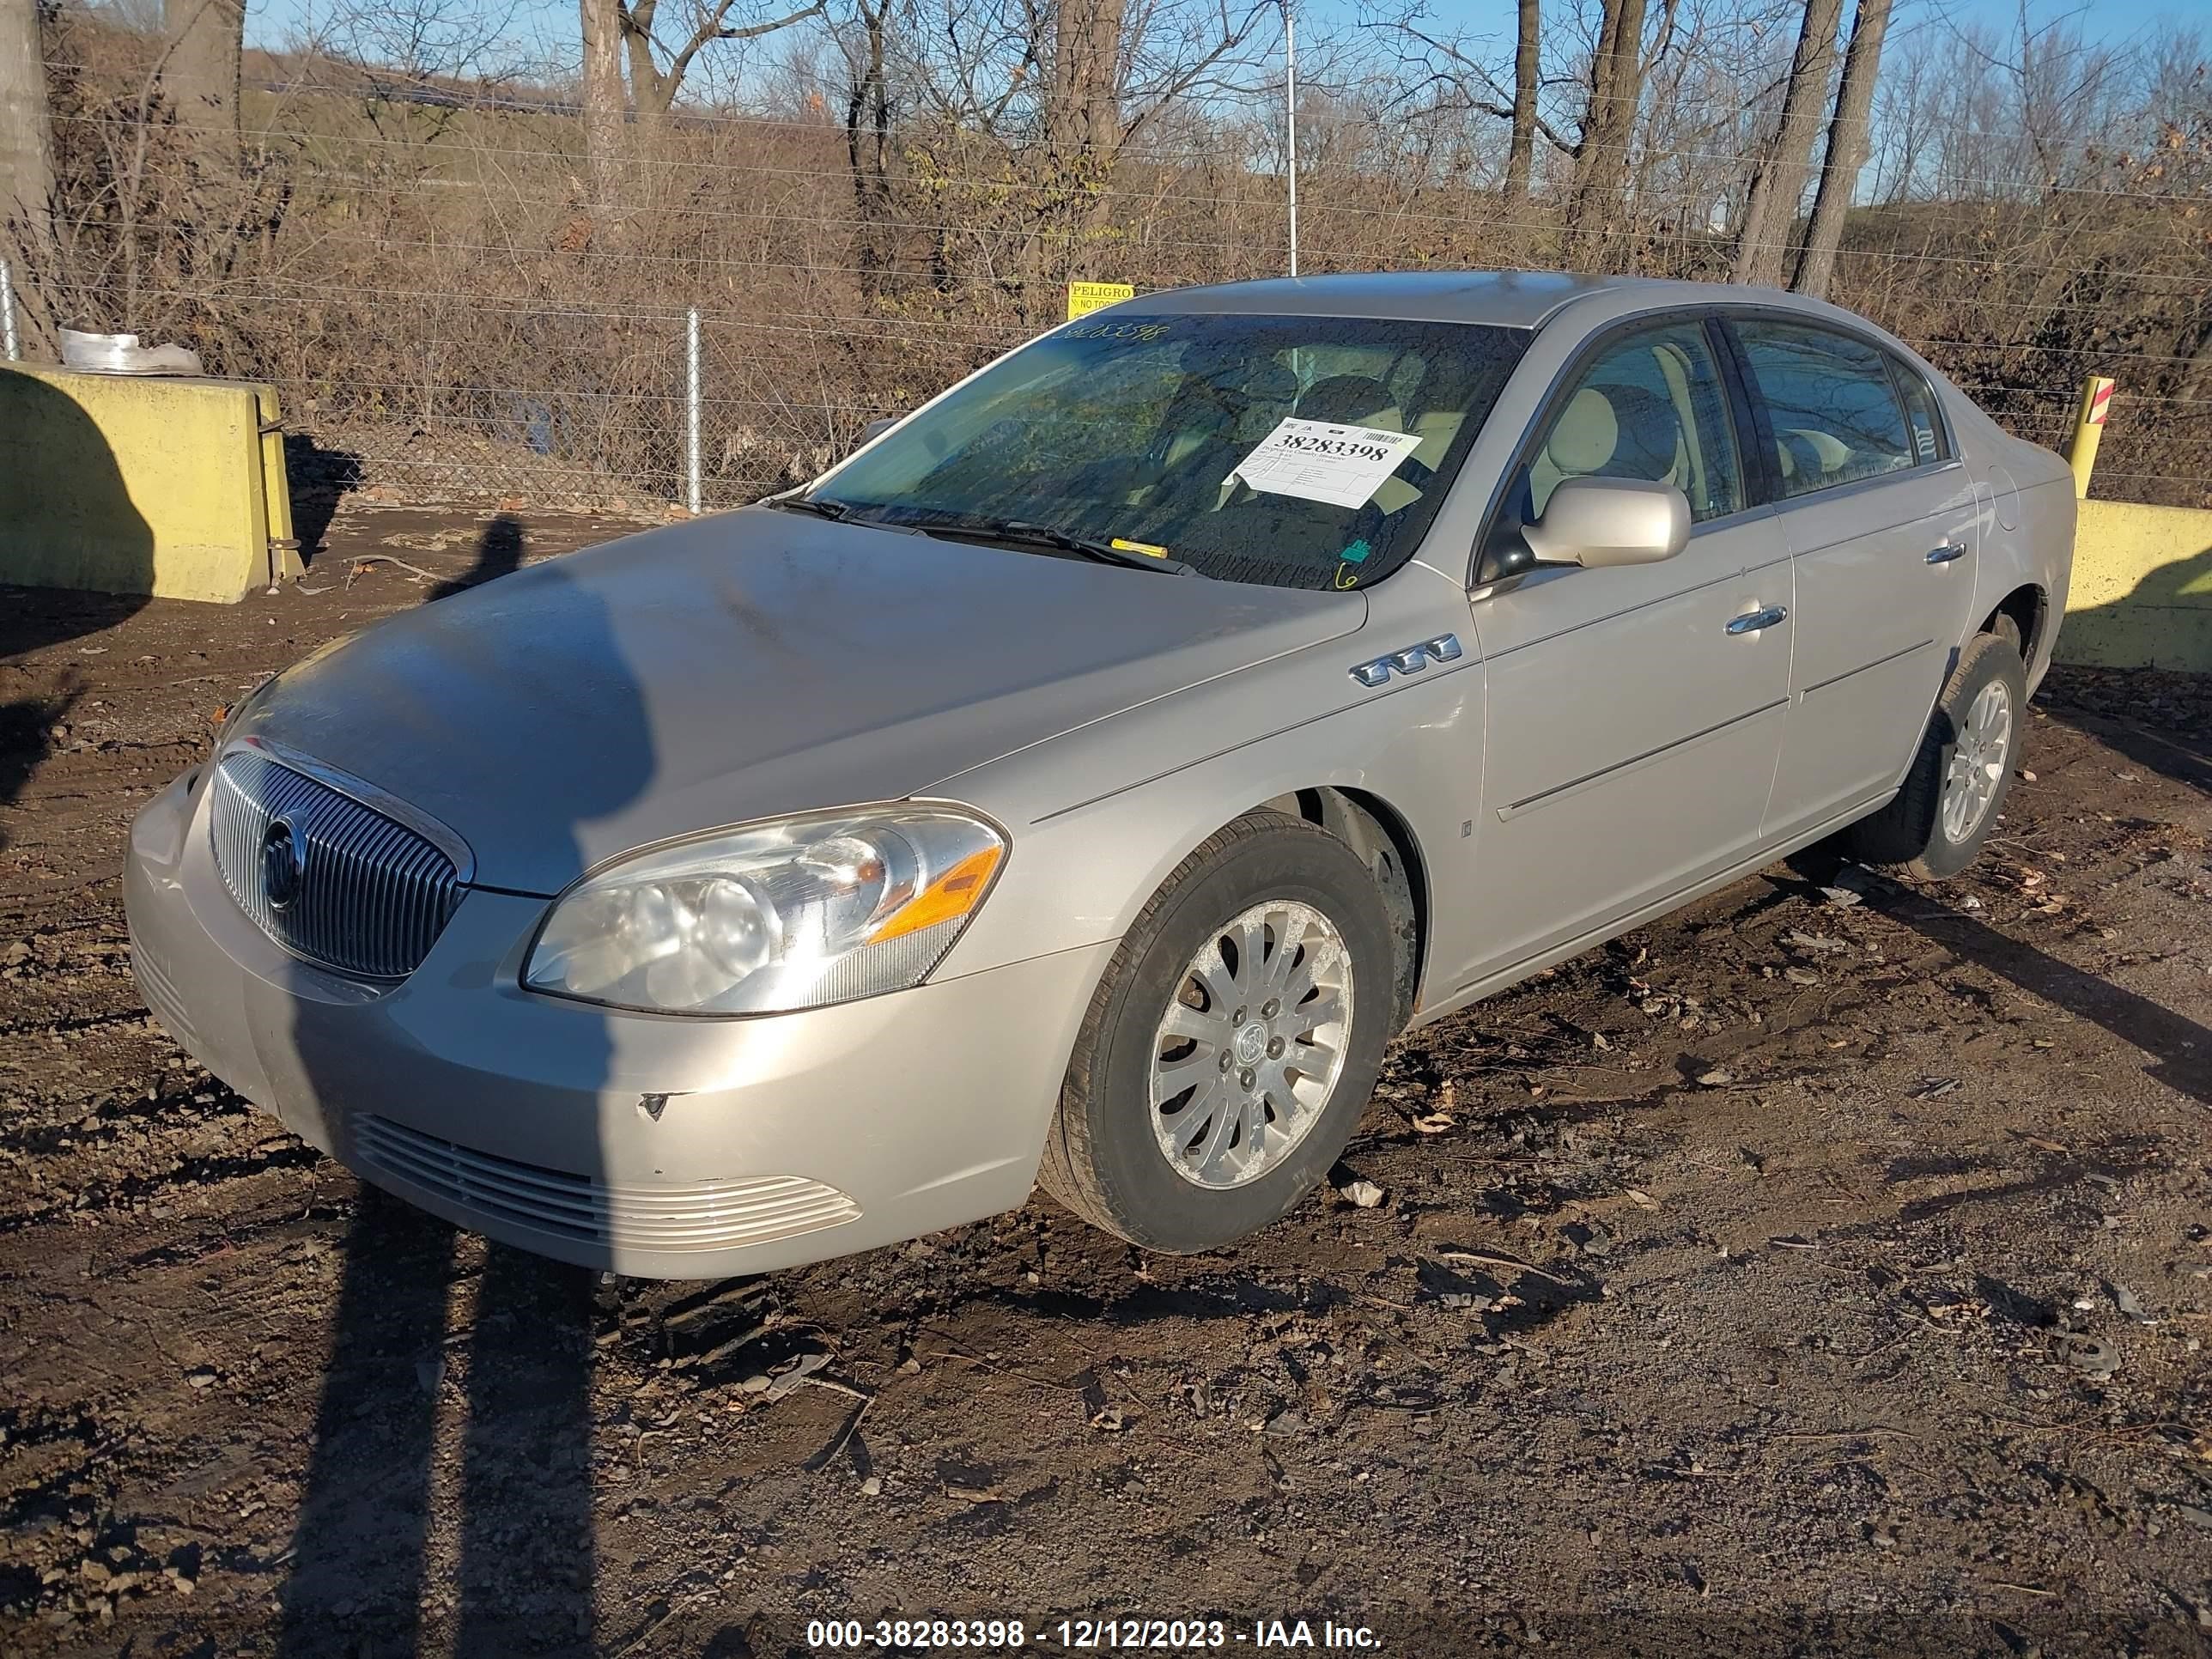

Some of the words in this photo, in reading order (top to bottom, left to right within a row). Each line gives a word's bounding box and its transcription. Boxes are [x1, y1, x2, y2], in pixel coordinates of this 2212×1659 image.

[1073, 286, 1131, 298] PELIGRO
[1080, 299, 1092, 309] NO
[1273, 435, 1388, 461] 38283398
